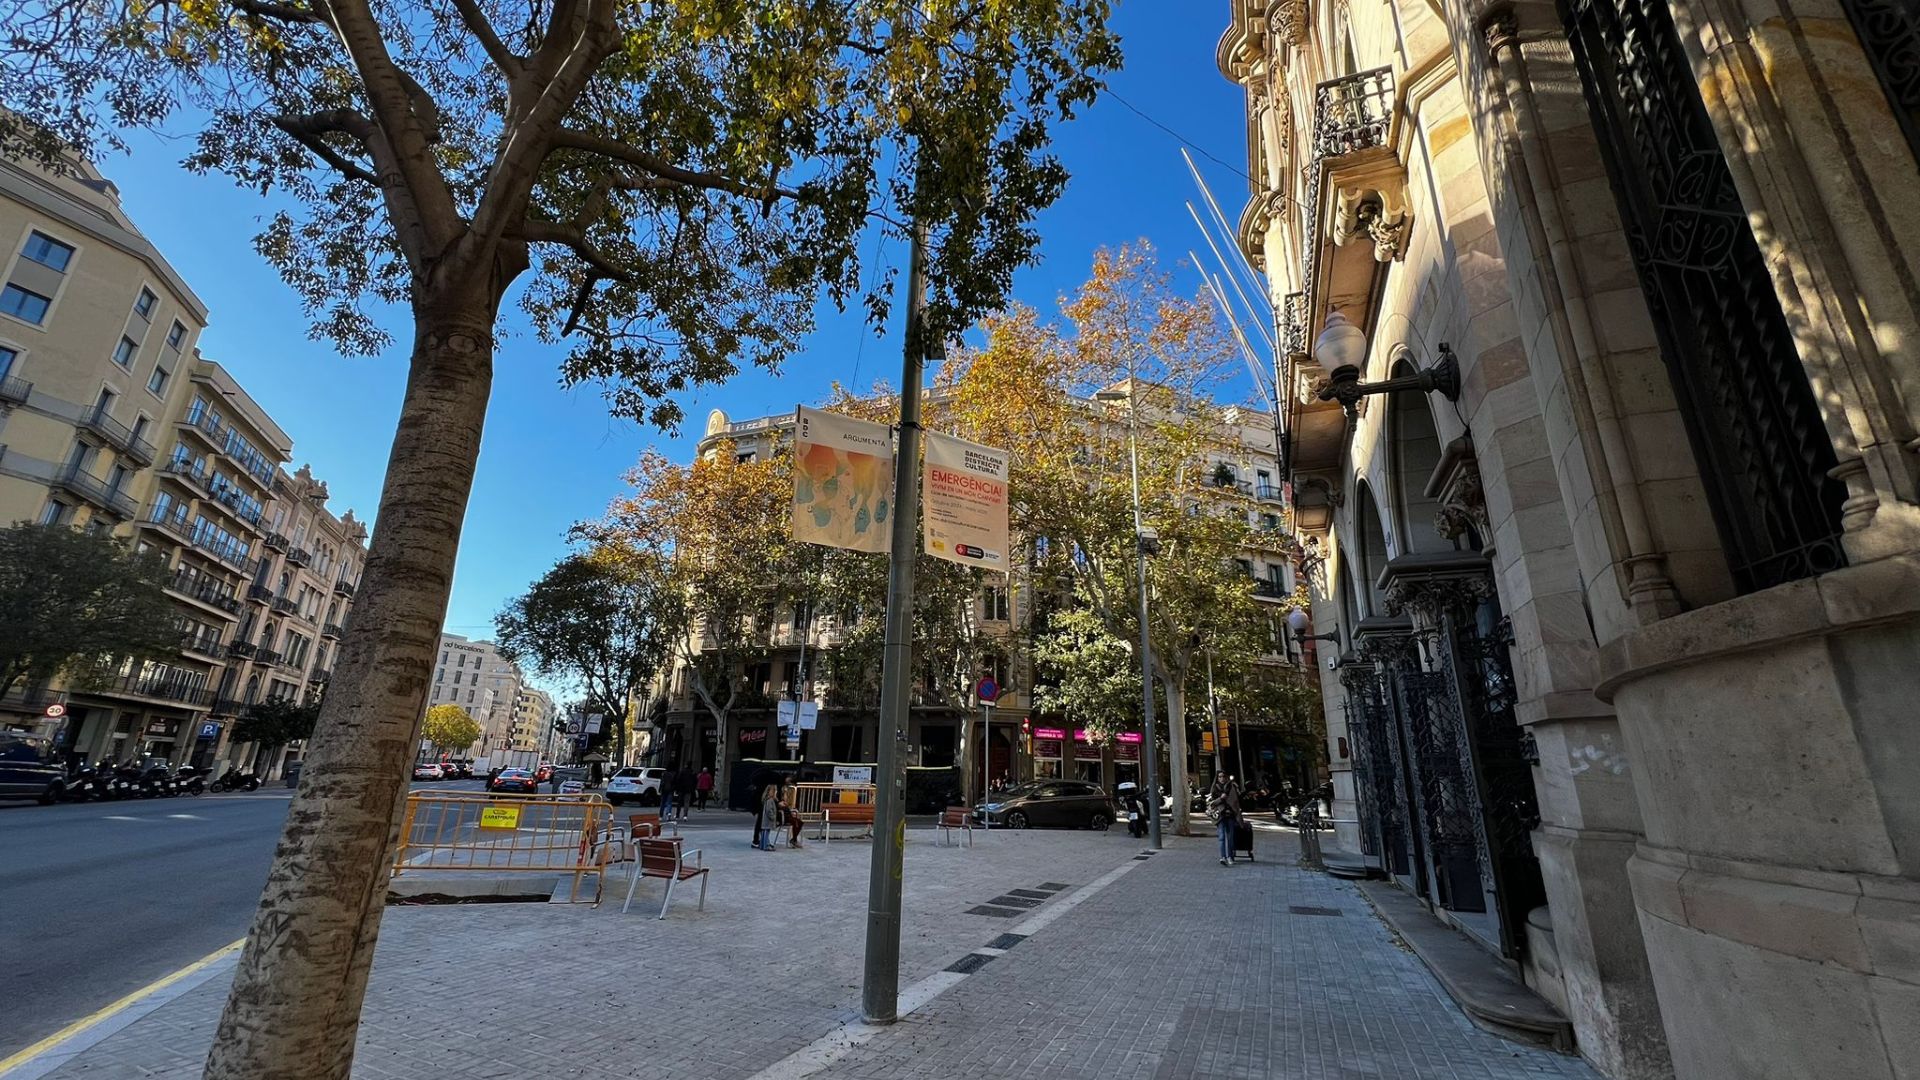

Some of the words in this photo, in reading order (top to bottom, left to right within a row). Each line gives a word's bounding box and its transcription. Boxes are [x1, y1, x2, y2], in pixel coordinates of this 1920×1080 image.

[843, 433, 886, 447] ARGUMENTA
[964, 449, 1003, 466] BARCELONA
[964, 456, 1001, 471] DISTRICTE
[964, 462, 999, 476] CULTURAL
[931, 470, 1003, 498] EMERGÈNCIA!
[454, 643, 485, 654] barcelona
